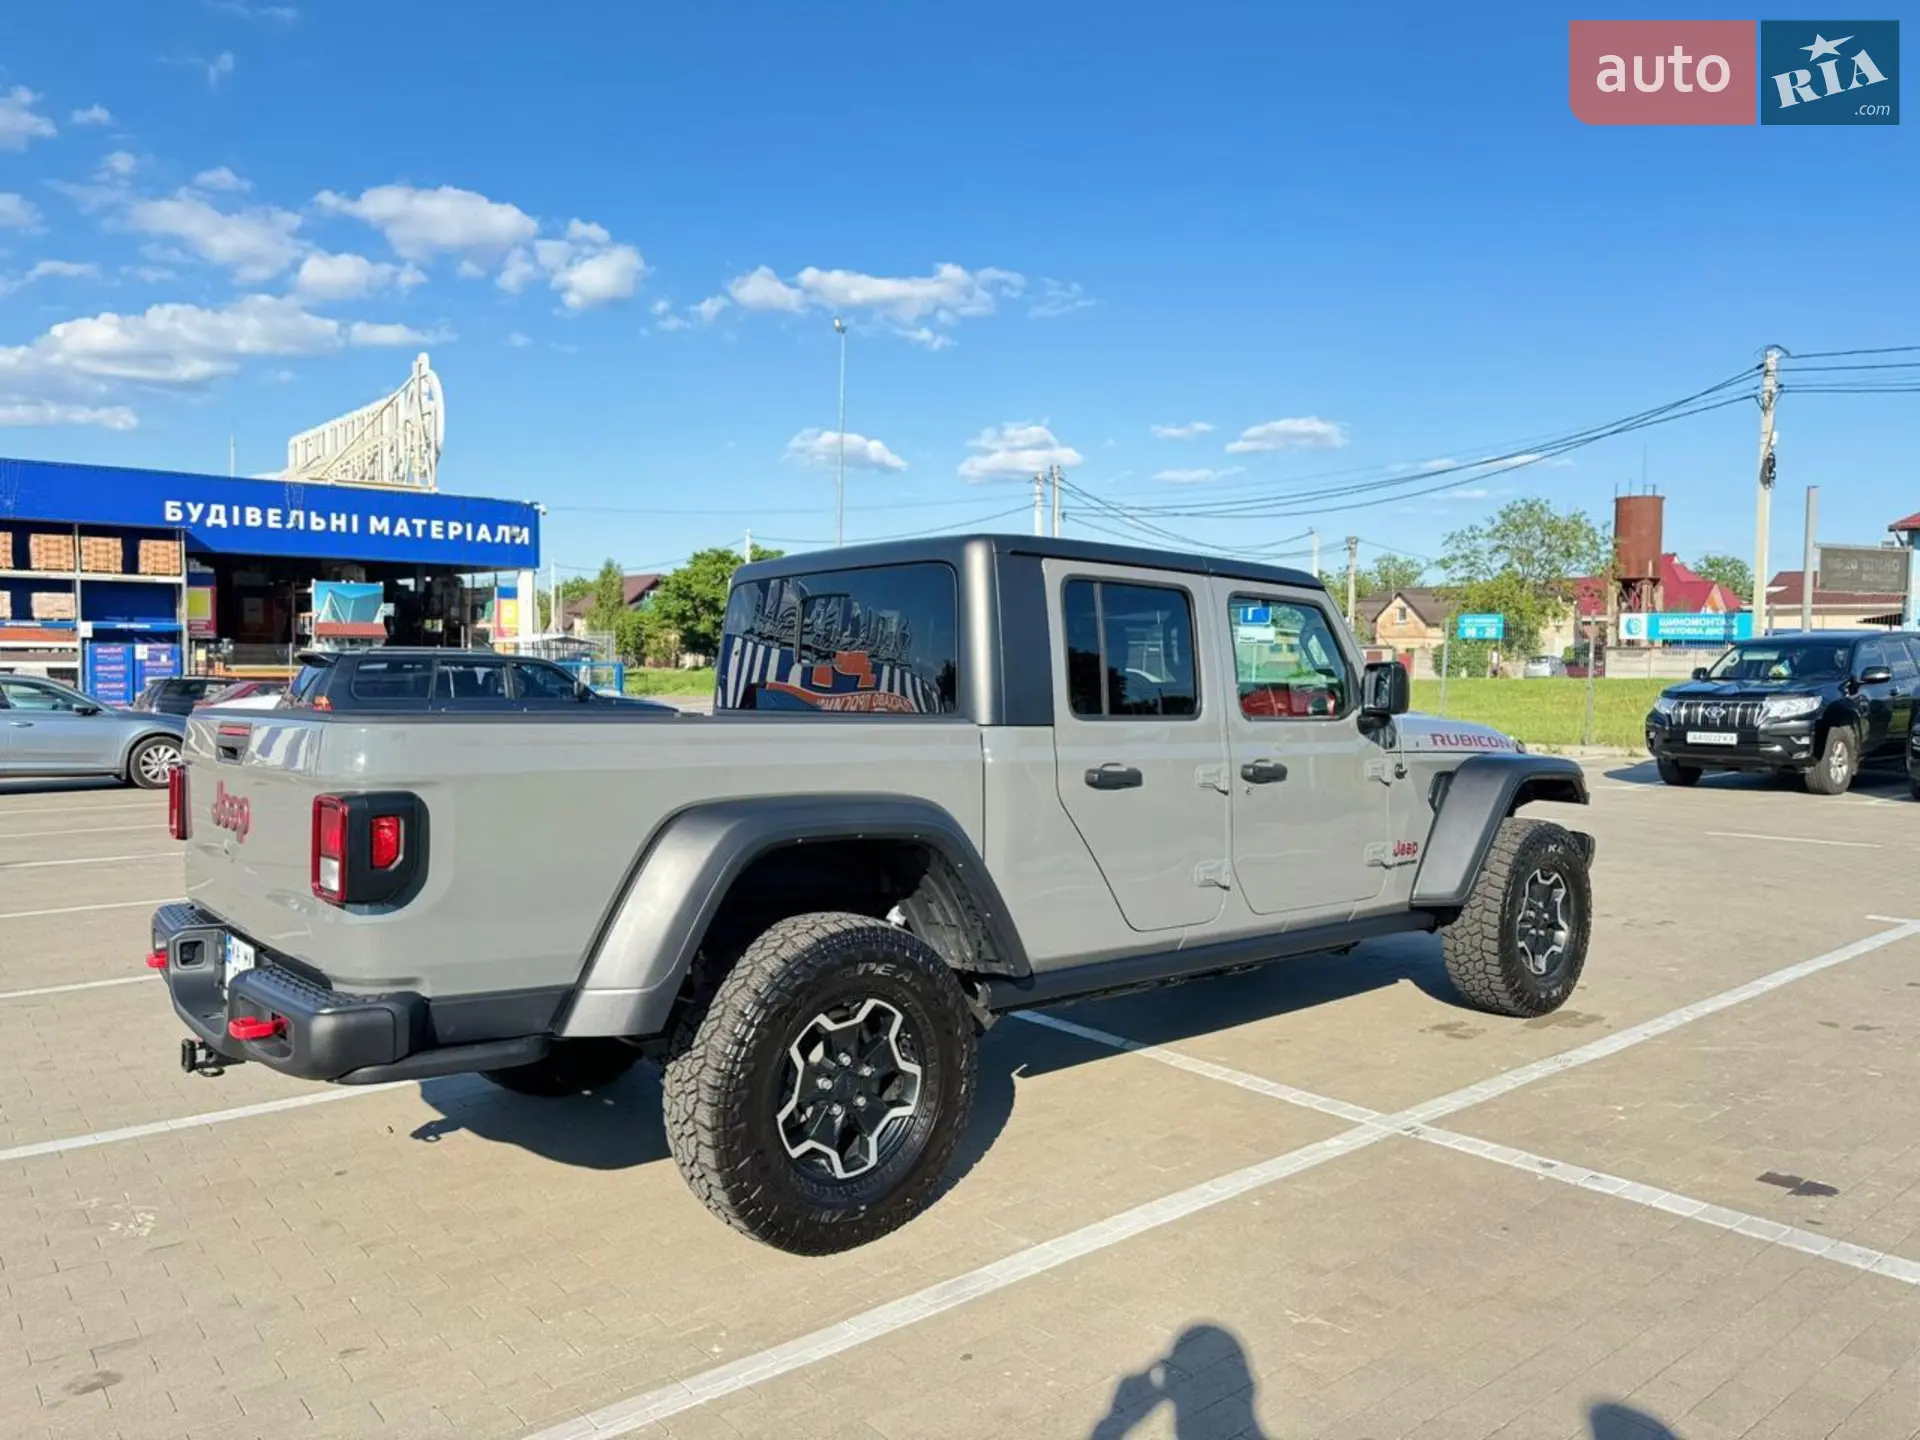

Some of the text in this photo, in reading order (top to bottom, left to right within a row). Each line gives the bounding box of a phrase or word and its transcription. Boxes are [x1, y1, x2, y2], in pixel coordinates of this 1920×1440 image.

[164, 500, 529, 545] БУДІВЕЛЬНІ МАТЕРІАЛИ
[1430, 733, 1511, 749] RUBICON
[211, 779, 250, 844] Jeep
[1393, 840, 1418, 857] Jeep
